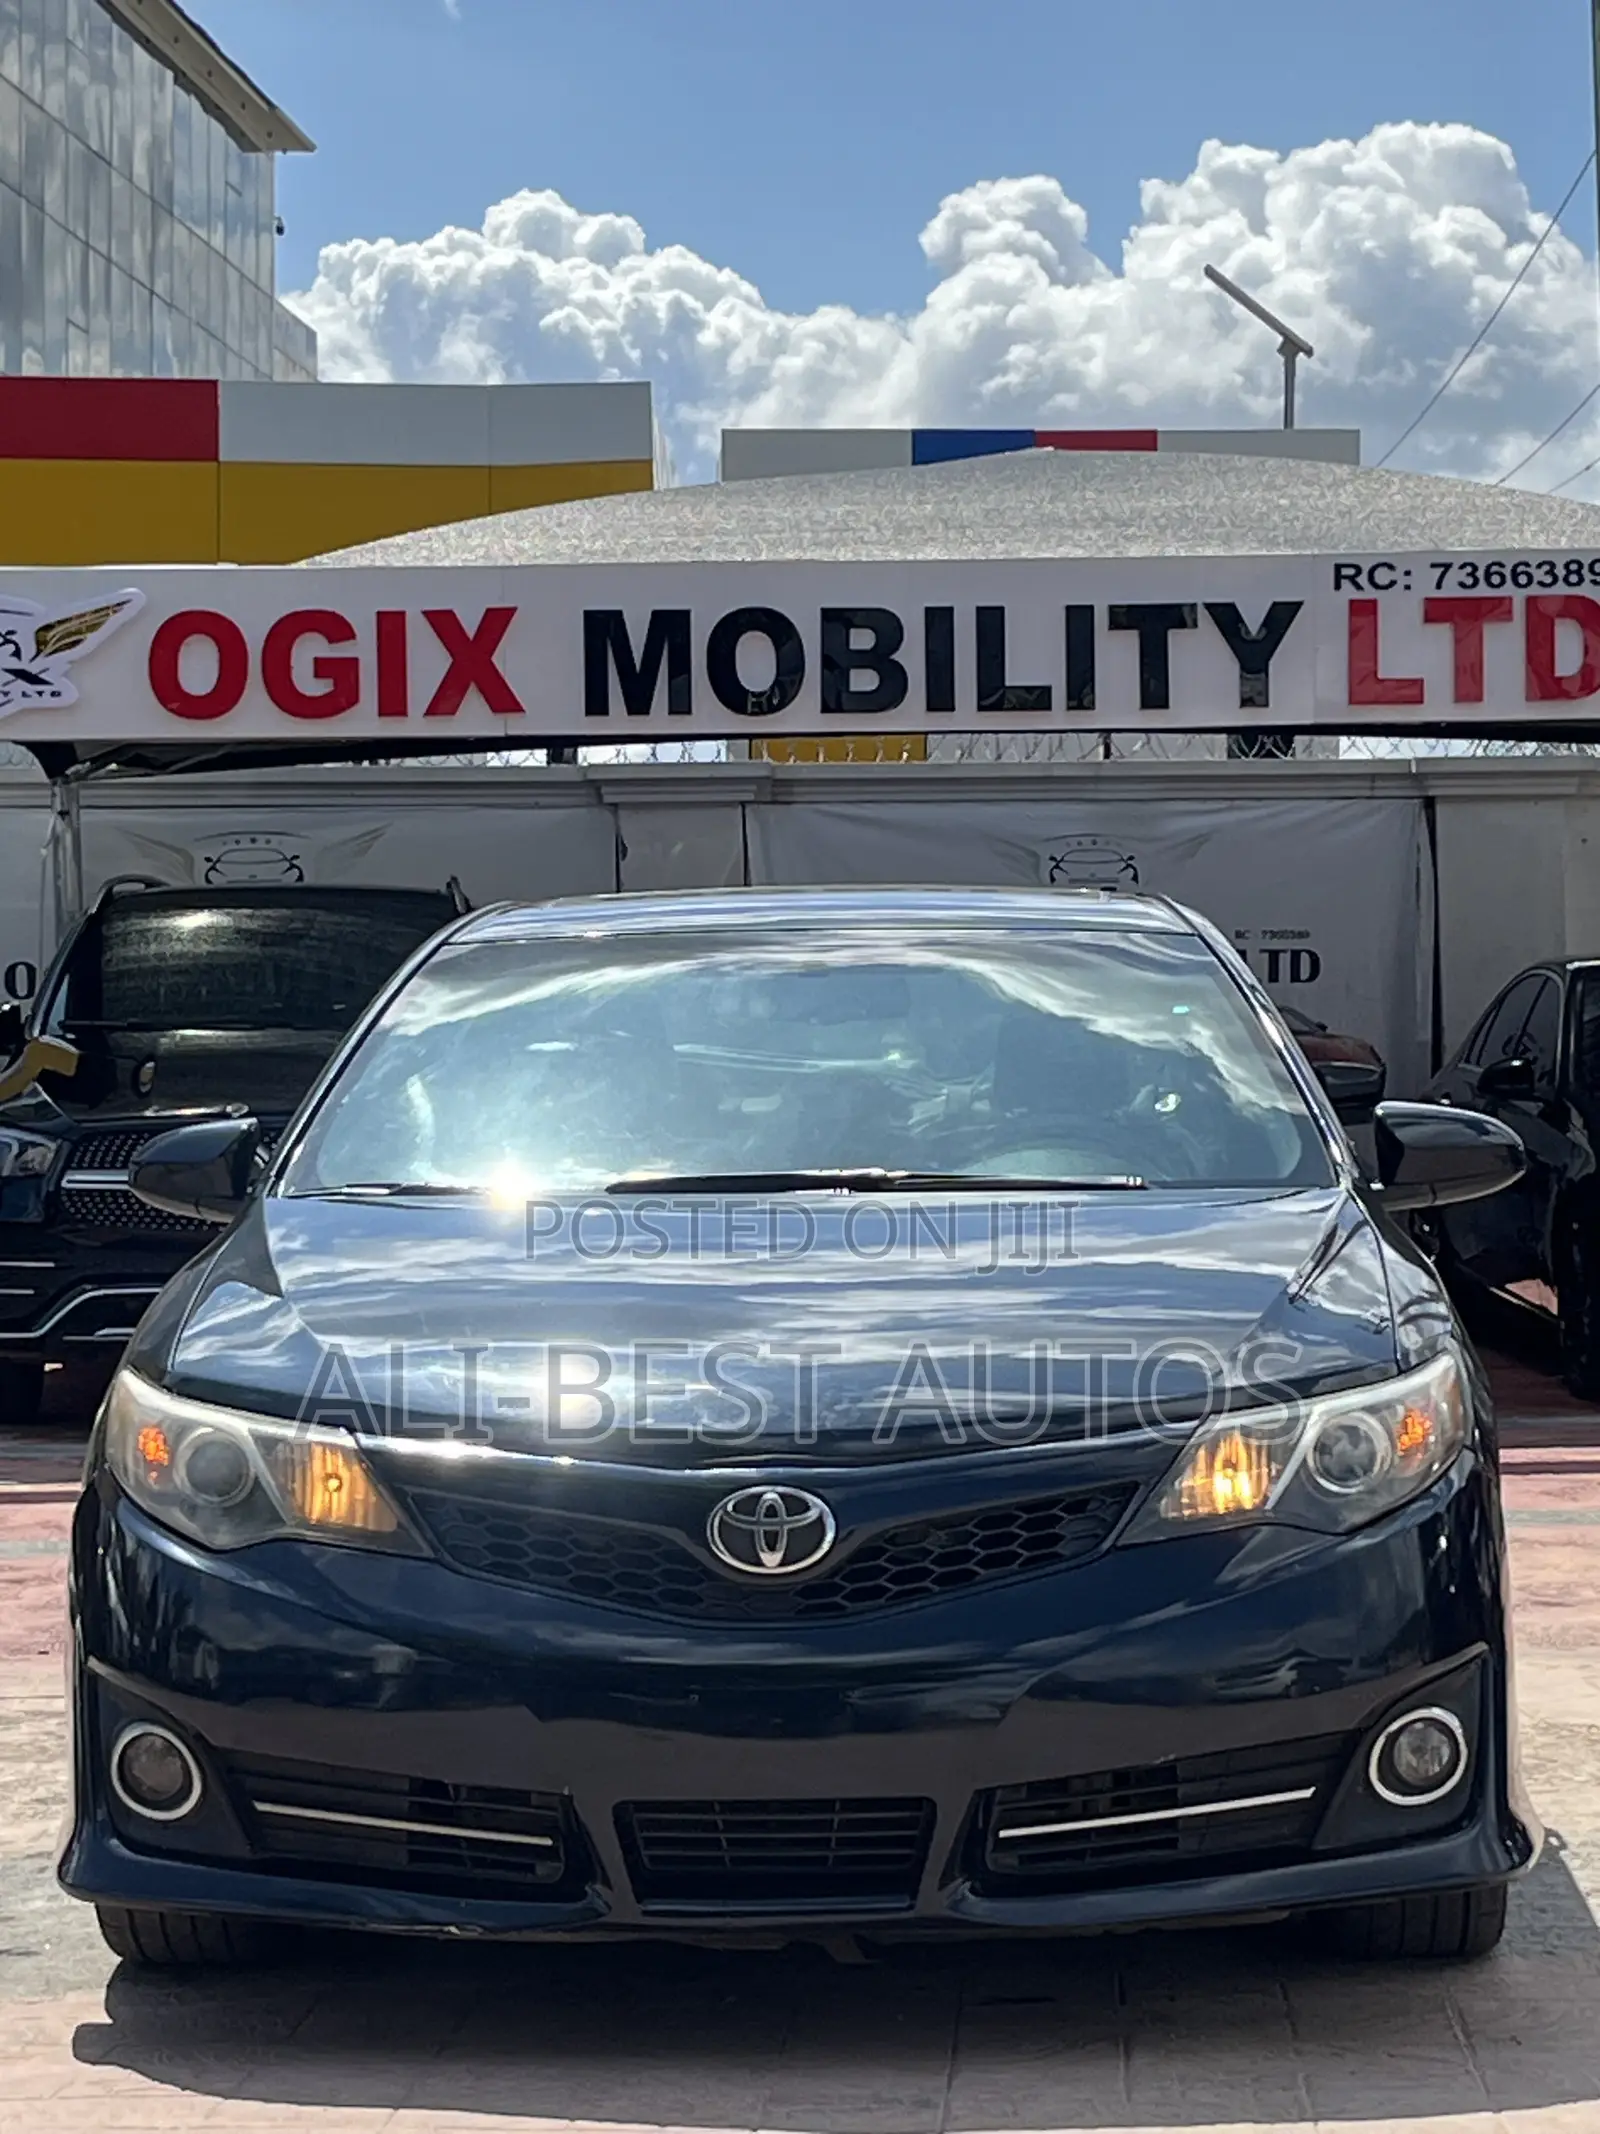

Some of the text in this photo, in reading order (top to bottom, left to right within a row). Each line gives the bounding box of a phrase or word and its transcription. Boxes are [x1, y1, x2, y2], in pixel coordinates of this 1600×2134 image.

[1333, 562, 1412, 591] RC:
[148, 594, 1600, 720] OGIX MOBILITY LTD
[1236, 948, 1321, 983] TD
